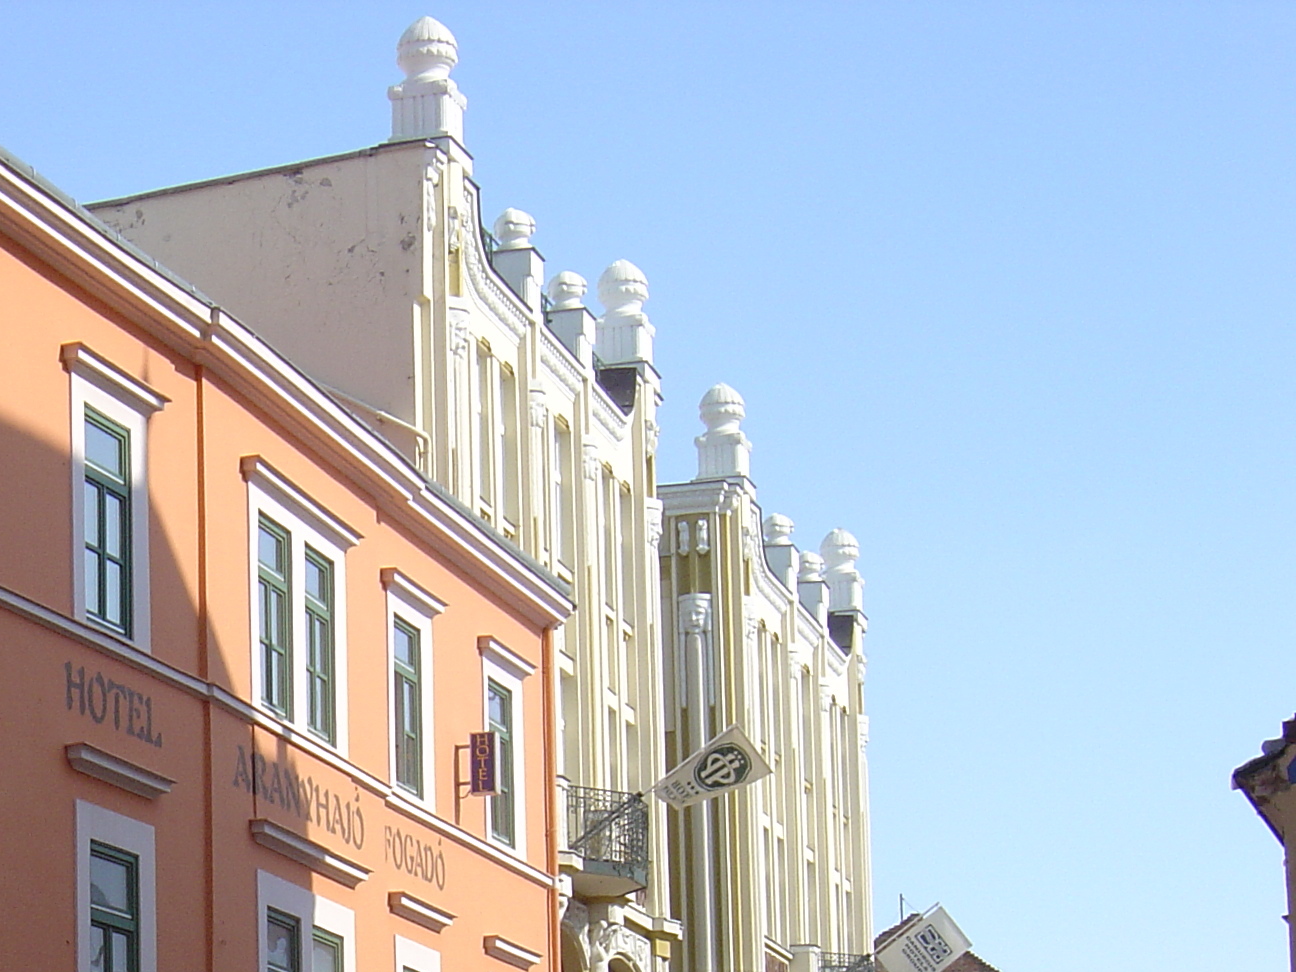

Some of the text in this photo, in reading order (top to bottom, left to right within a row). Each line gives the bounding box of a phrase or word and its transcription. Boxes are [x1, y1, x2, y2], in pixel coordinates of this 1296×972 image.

[64, 661, 162, 748] HOTEL
[475, 735, 489, 793] HOTEL
[232, 744, 445, 891] ARANYHAJÓ FOGADÓ
